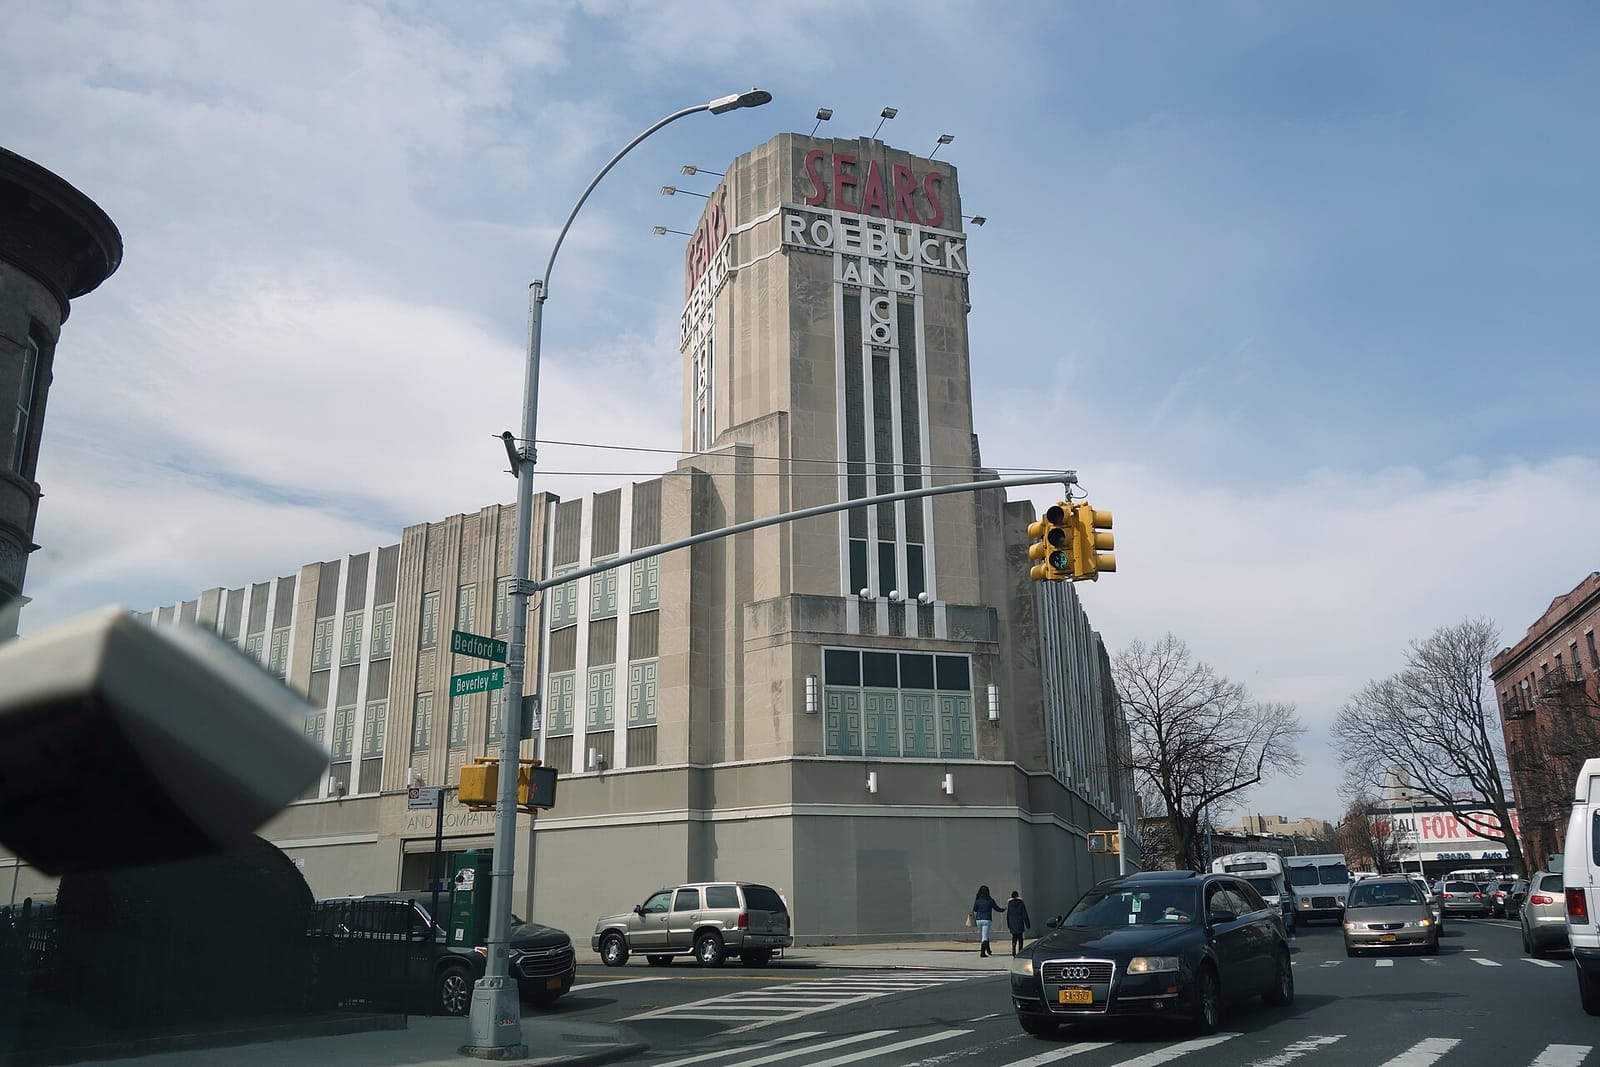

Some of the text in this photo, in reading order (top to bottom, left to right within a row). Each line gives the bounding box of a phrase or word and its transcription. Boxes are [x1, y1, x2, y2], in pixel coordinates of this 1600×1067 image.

[803, 149, 944, 228] SEARS
[784, 213, 967, 273] ROEBUCK
[842, 261, 916, 291] AND
[869, 296, 892, 344] CO
[454, 633, 506, 658] Bedford Av
[456, 672, 499, 693] Beverley Rd
[407, 815, 434, 830] AND
[1421, 815, 1460, 839] FOR
[1482, 851, 1504, 860] Auto
